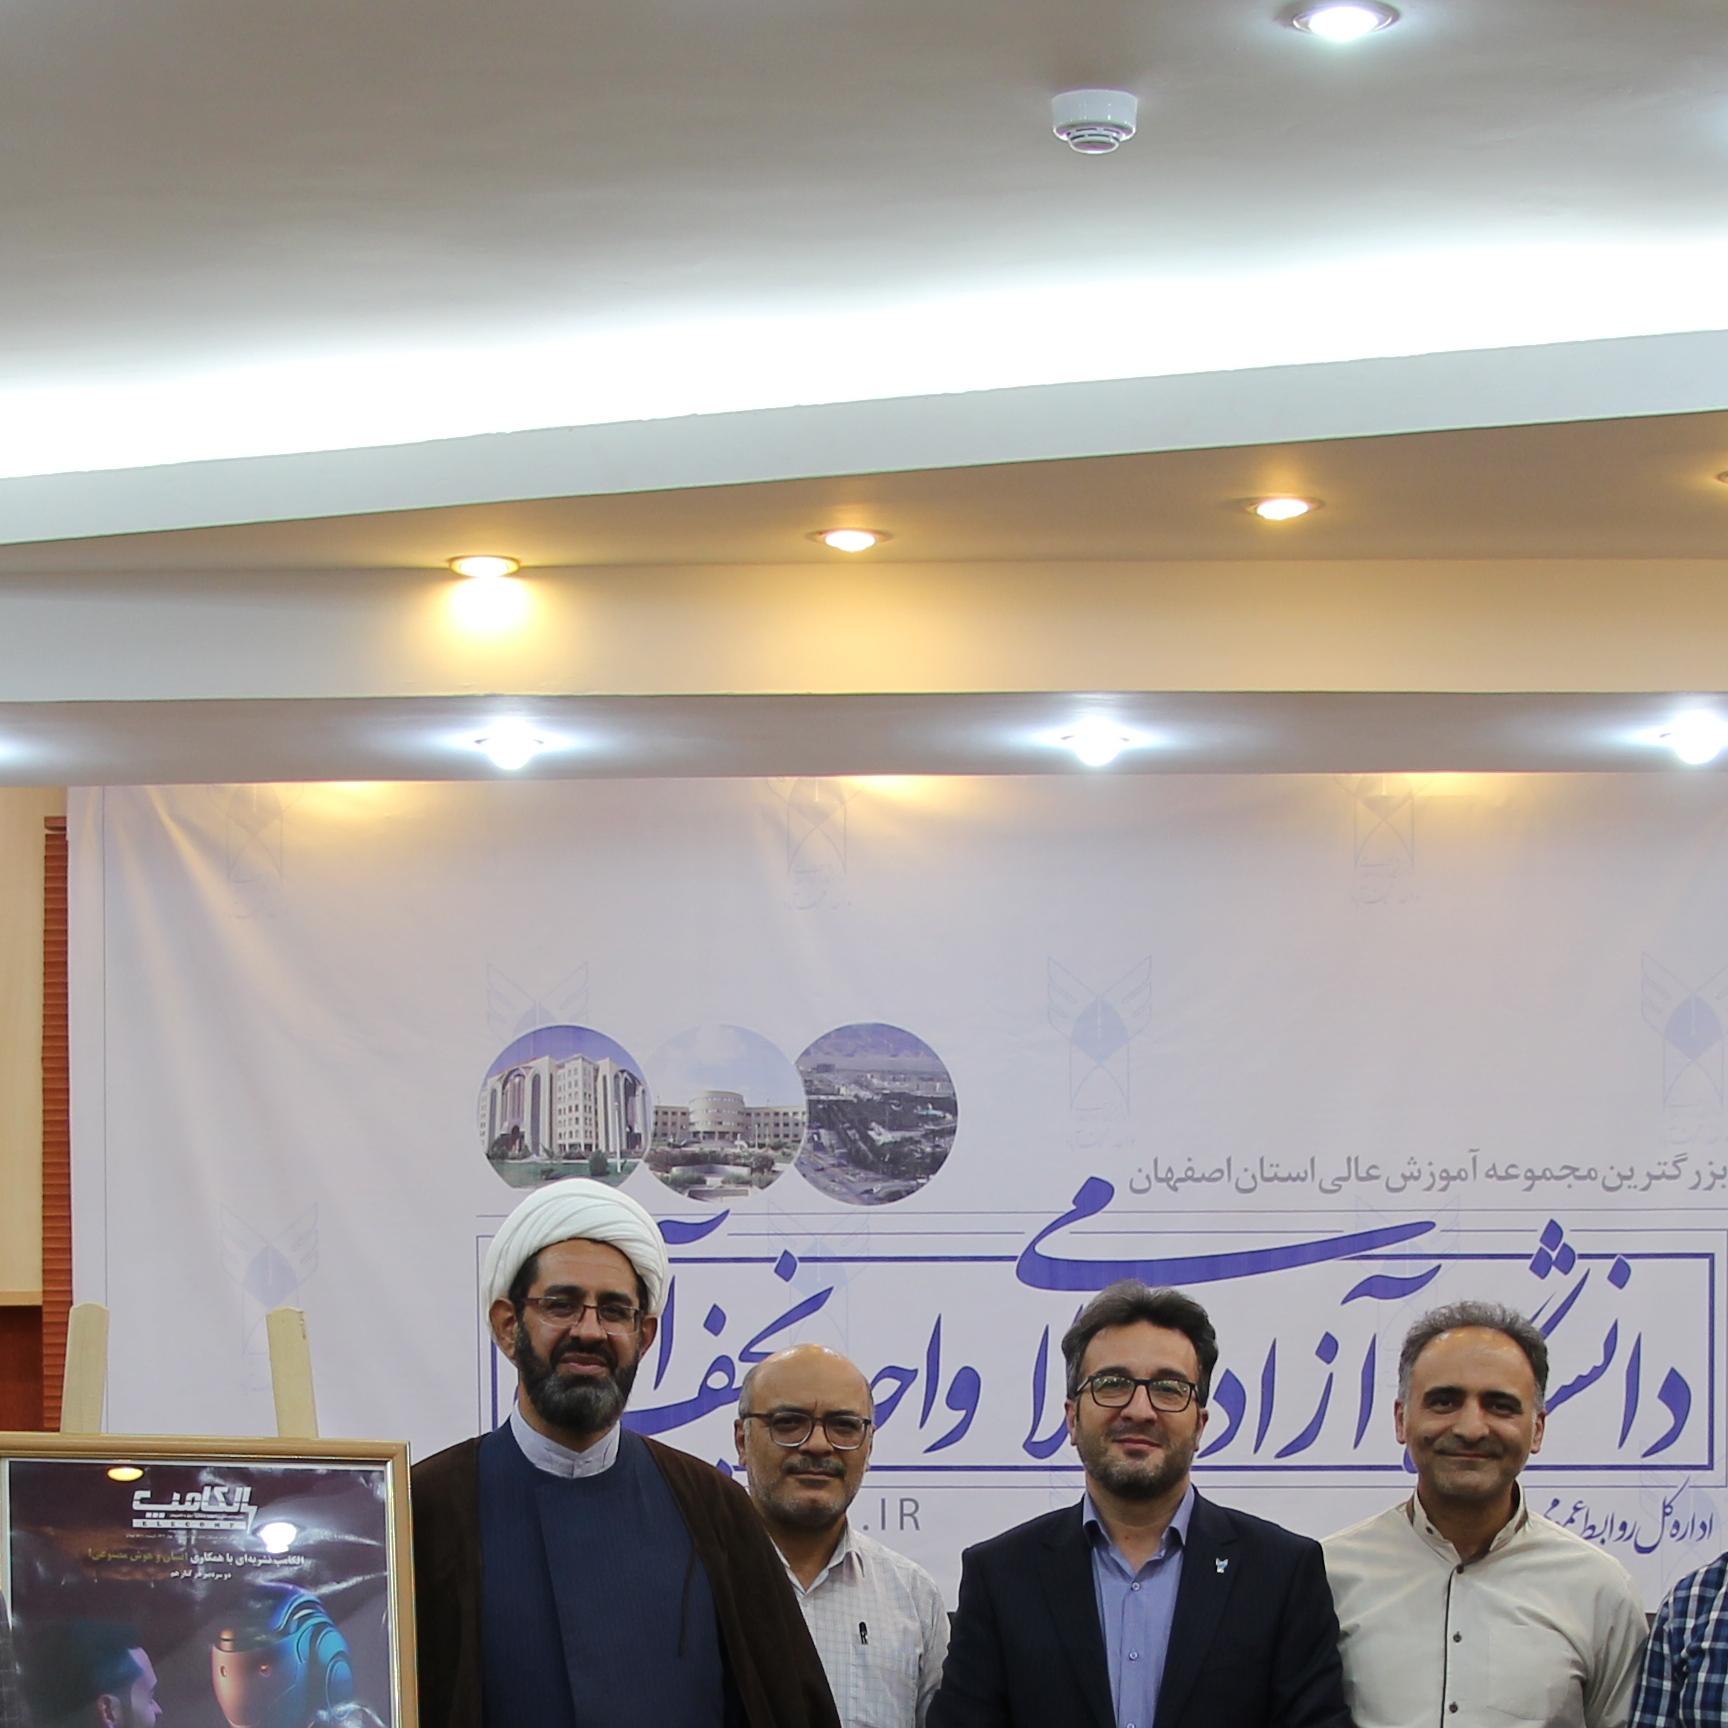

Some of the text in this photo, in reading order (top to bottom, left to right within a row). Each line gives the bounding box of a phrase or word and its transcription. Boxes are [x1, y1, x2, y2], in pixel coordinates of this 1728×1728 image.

[1128, 1147, 1728, 1195] بزرگترین مجموعه آموزش عالی استان اصفهان
[871, 1313, 981, 1454] واح
[1197, 1263, 1442, 1460] آزاد
